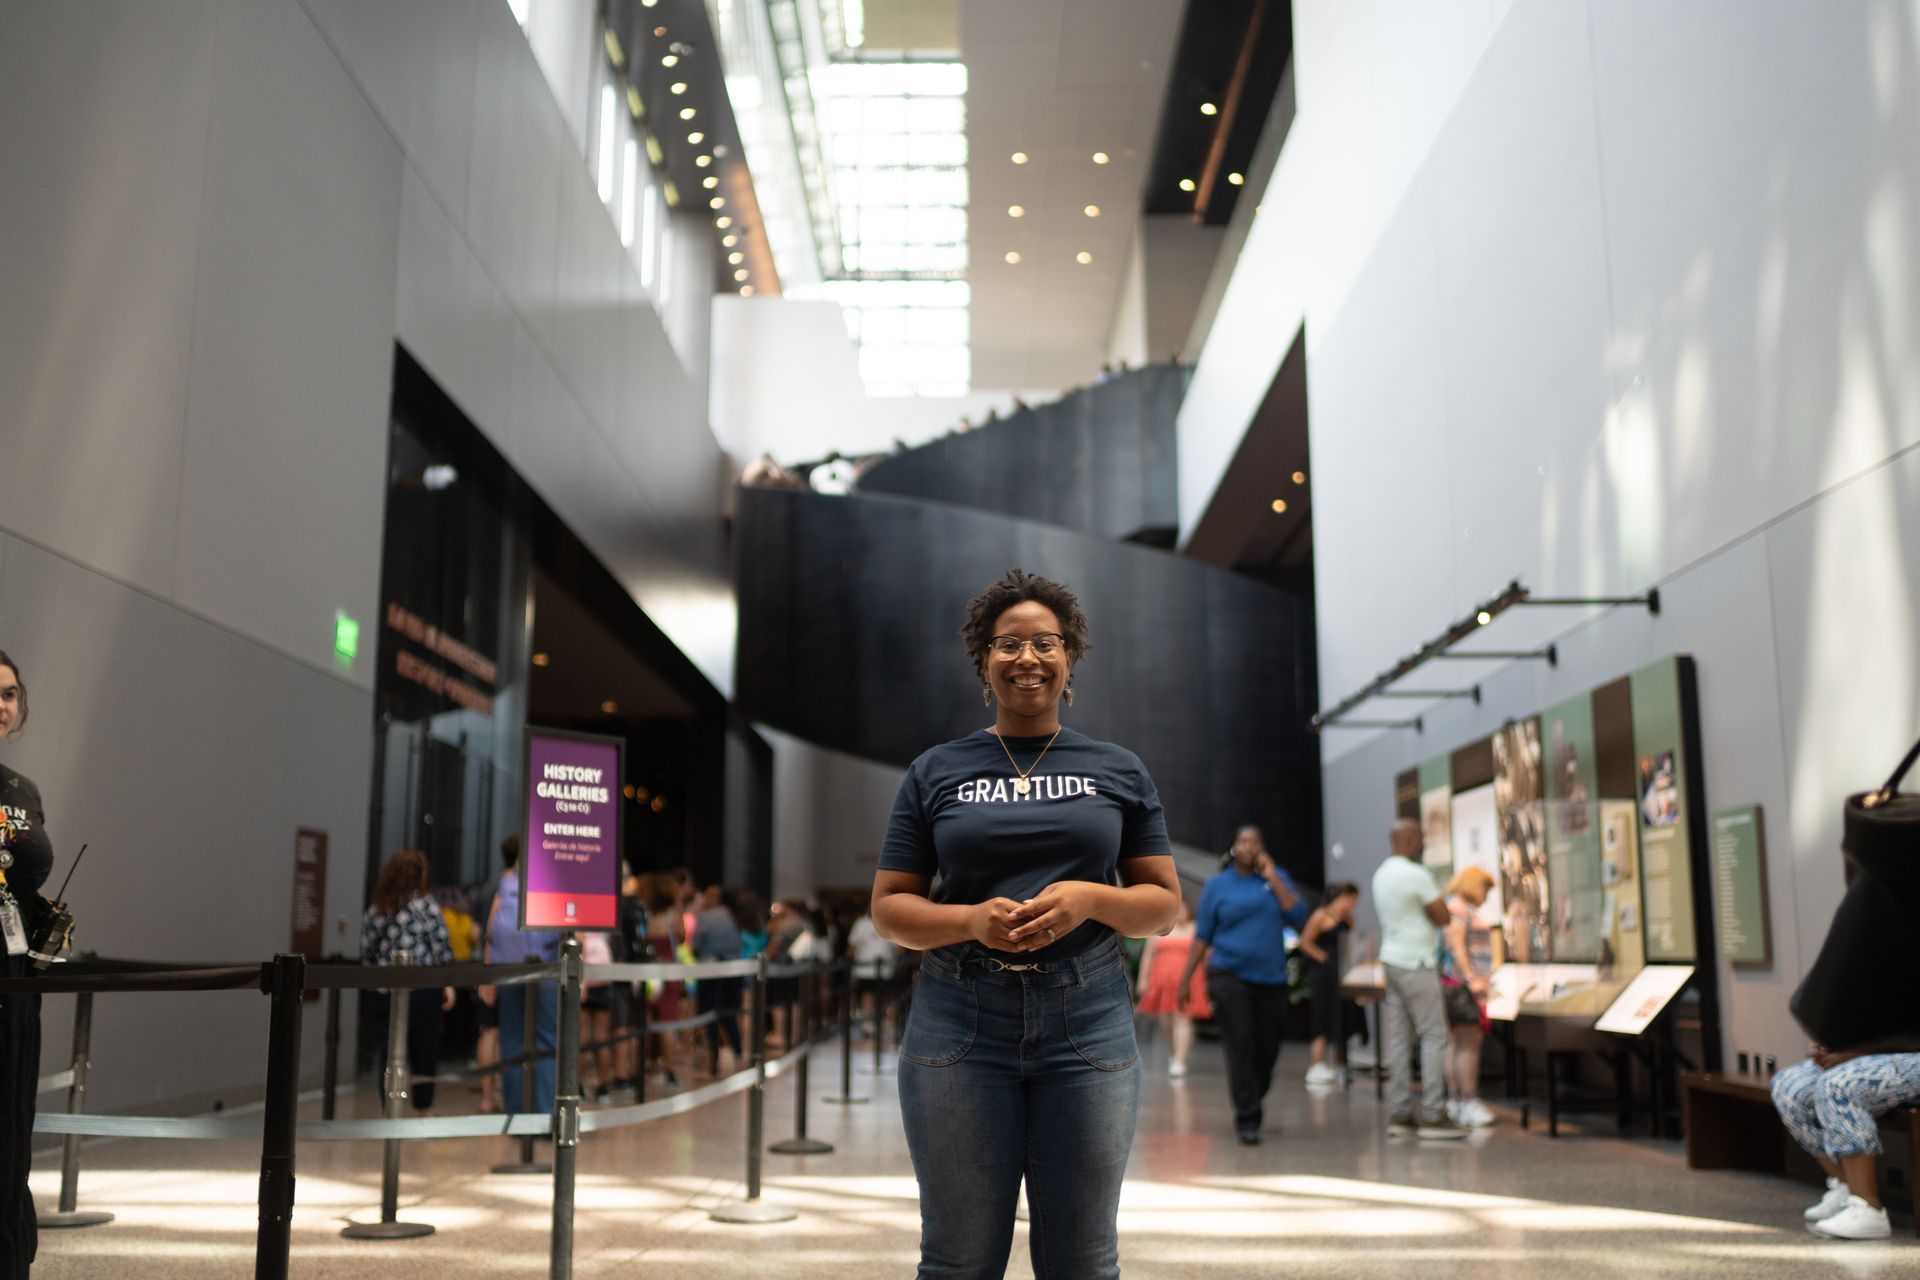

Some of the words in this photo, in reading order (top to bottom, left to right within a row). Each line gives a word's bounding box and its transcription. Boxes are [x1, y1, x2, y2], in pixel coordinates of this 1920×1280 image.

[544, 763, 602, 784] HISTORY
[537, 781, 609, 803] GALLERIES
[544, 822, 575, 836] ENTER
[575, 824, 601, 838] HERE
